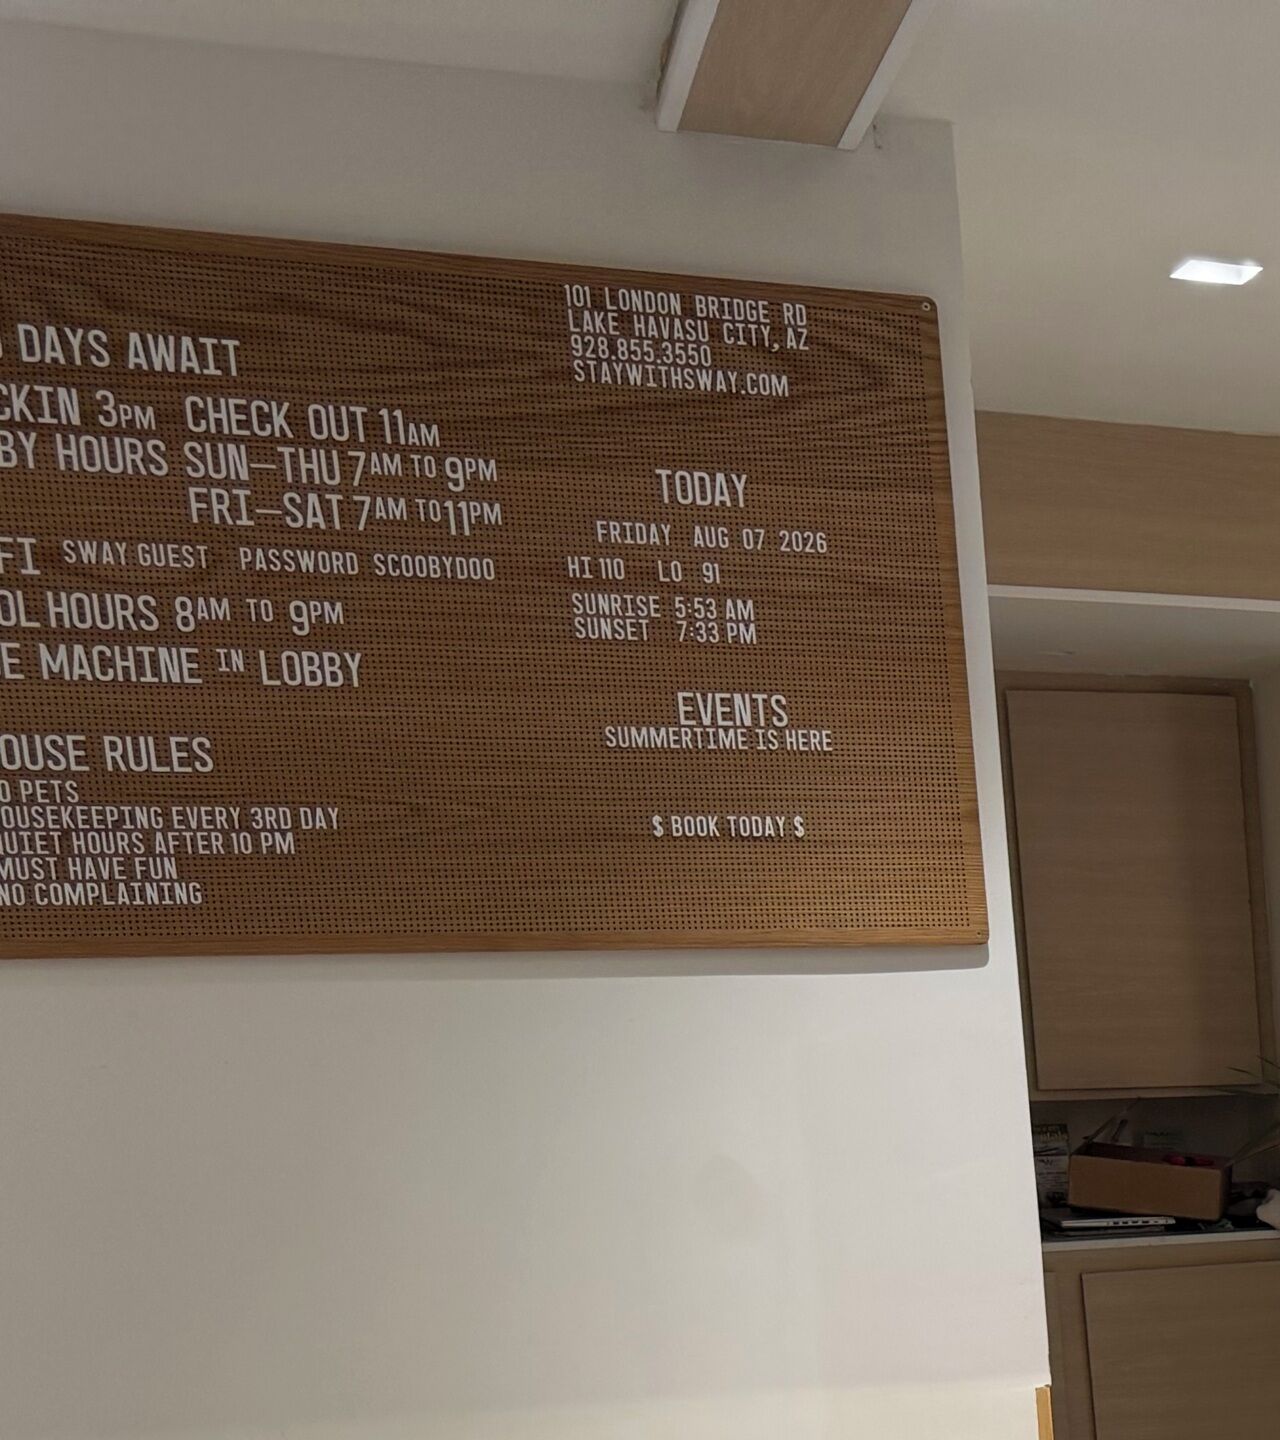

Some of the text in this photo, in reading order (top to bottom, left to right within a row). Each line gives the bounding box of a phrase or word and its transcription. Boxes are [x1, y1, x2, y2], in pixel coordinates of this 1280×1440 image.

[563, 284, 807, 327] 101 LONDON BRIDGE RD
[567, 309, 809, 352] LAKE HAVASU CITY, AZ
[17, 324, 111, 368] DAYS
[128, 332, 240, 376] AWAIT
[570, 337, 712, 368] 928.855.3550
[573, 359, 790, 398] STAYWITHSWAY.COM
[185, 396, 294, 439] CHECK
[308, 404, 368, 444] OUT
[55, 433, 169, 476] HOURS
[411, 454, 437, 479] TO
[655, 469, 748, 508] TODAY
[596, 521, 828, 554] FRIDAY AUG 07 2026
[62, 539, 128, 567] SWAY
[137, 543, 208, 570] GUEST
[239, 547, 359, 576] PASSWORD
[373, 553, 496, 582] SCOOBYDOO
[567, 556, 721, 585] HI 110 LO 91
[47, 590, 159, 632] HOURS
[245, 598, 274, 623] TO
[571, 592, 755, 621] SUNRISE 5:53 AM
[574, 620, 757, 645] SUNSET 7:33 PM
[38, 643, 202, 685] MACHINE
[216, 648, 245, 674] IN
[259, 650, 362, 688] LOBBY
[677, 691, 790, 728] EVENTS
[103, 736, 214, 773] RULES
[604, 726, 833, 752] SUMMERTIME IS HERE
[19, 780, 79, 803] PETS
[172, 807, 242, 830] EVERY
[250, 807, 292, 831] 3RD
[300, 807, 340, 831] DAY
[652, 814, 805, 839] $ BOOK TODAY $
[0, 831, 296, 856] UIET HOURS AFTER 10 PM
[68, 857, 126, 881] HAVE
[134, 857, 178, 881] FUN
[34, 882, 202, 906] COMPLAINING
